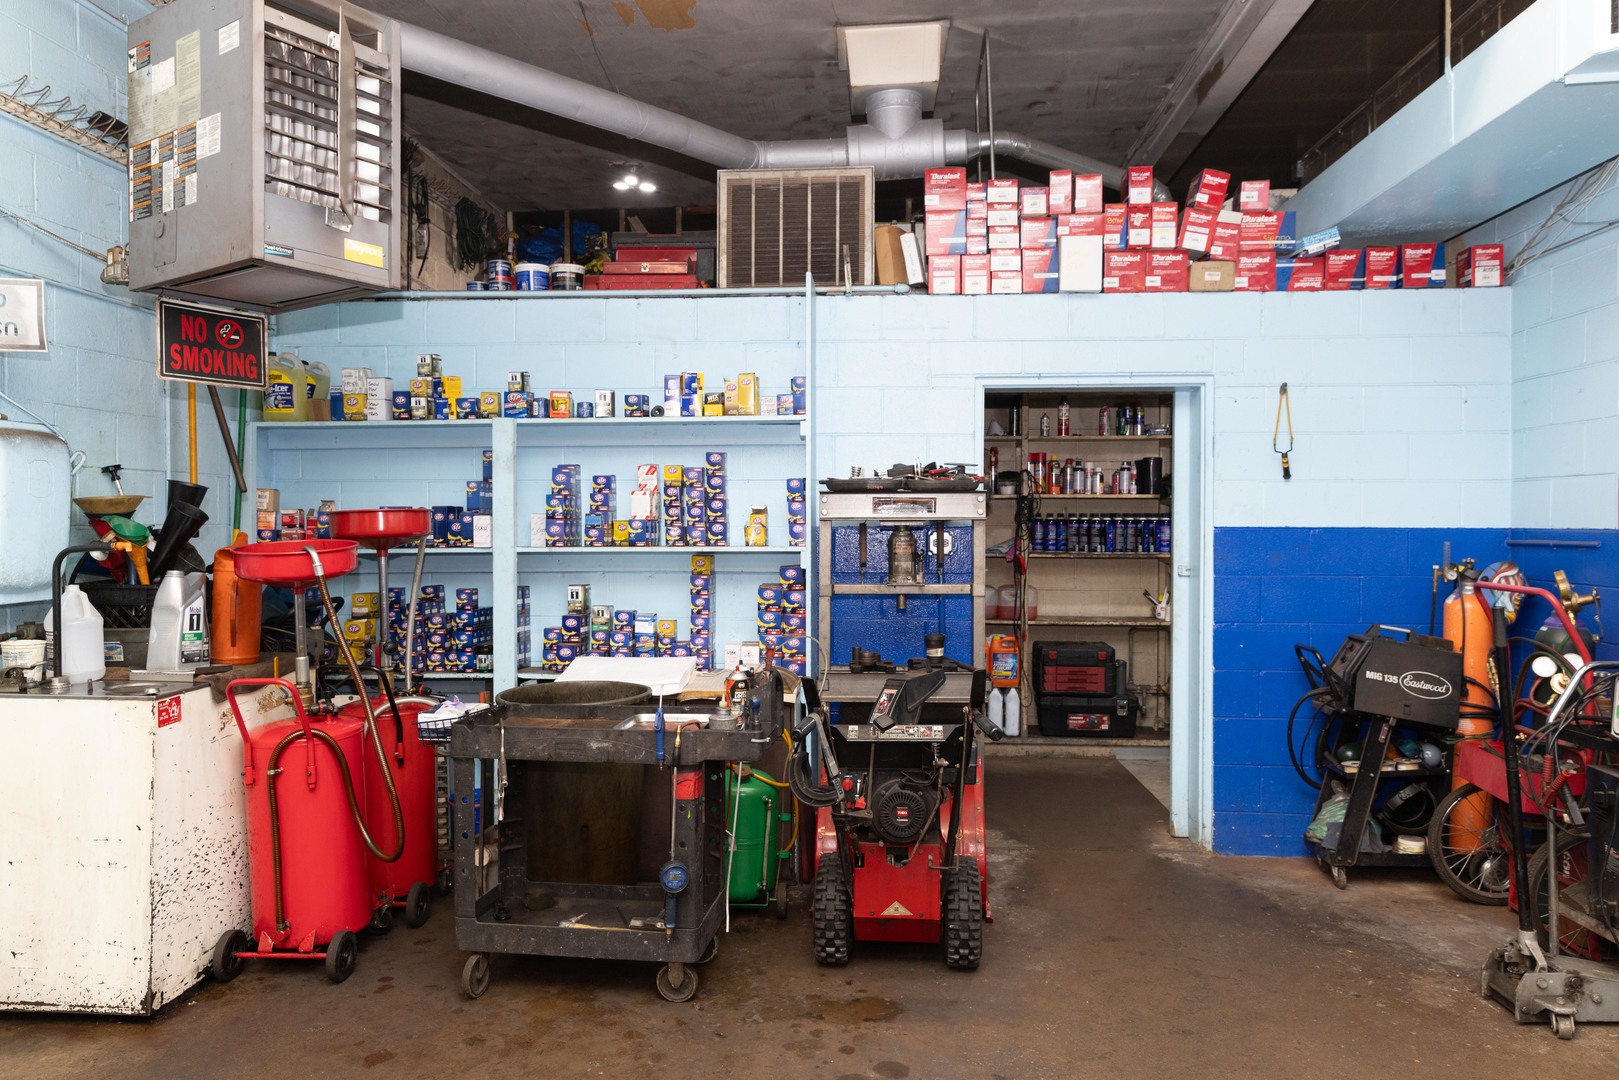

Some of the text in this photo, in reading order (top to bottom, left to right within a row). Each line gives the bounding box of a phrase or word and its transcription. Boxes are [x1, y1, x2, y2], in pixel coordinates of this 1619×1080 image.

[1205, 174, 1228, 184] Duralast
[1242, 215, 1278, 223] Duralast
[1152, 254, 1182, 262] Duralast
[182, 314, 207, 344] NO
[170, 344, 258, 378] SMOKING
[1366, 671, 1398, 684] MIG 135
[1403, 675, 1448, 693] Eastwood
